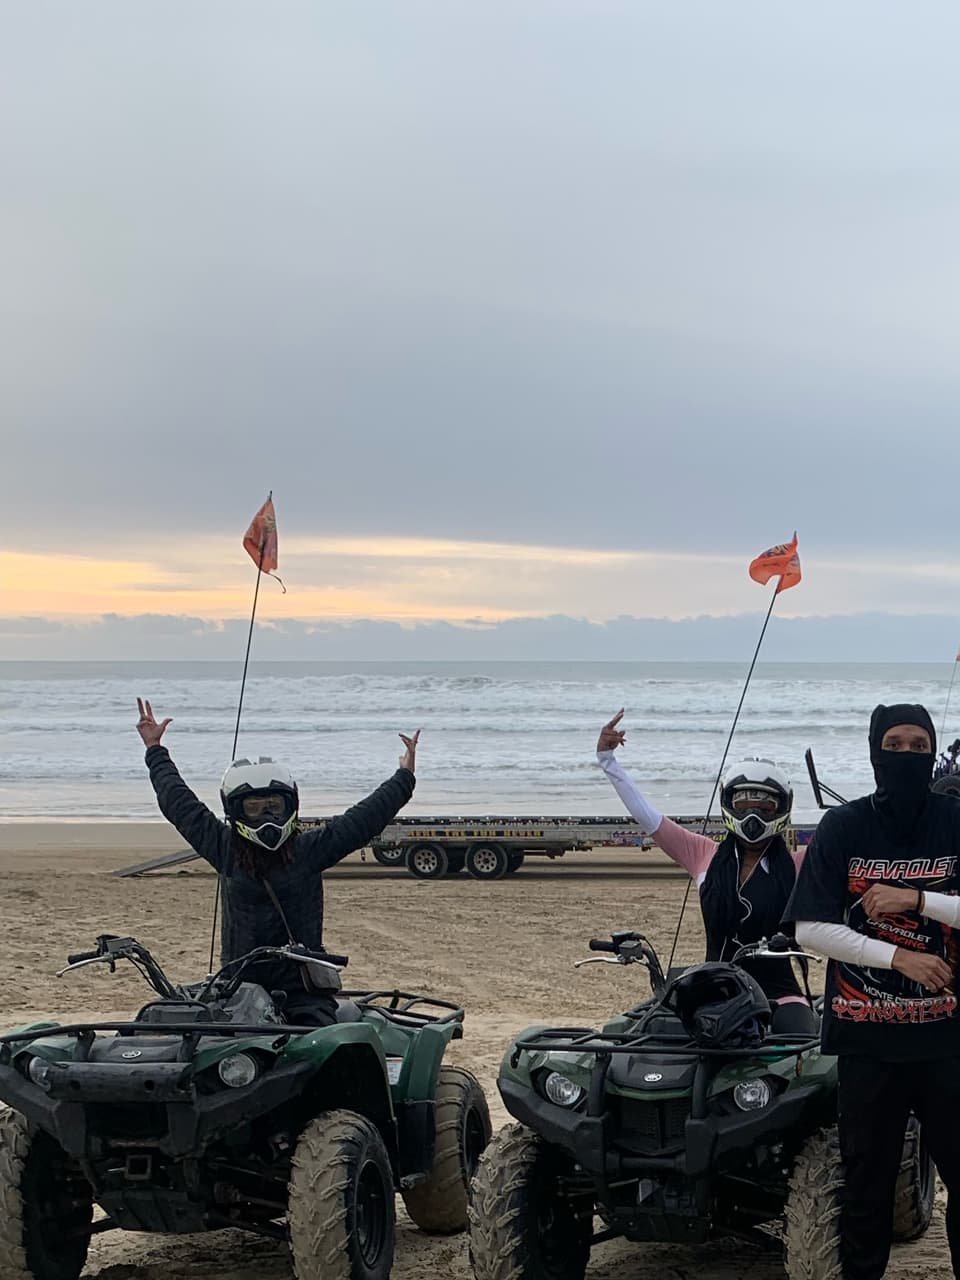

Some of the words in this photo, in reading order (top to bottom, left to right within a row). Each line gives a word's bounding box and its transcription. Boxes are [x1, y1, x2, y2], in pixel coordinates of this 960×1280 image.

[847, 856, 958, 880] CHEVROLET
[866, 918, 933, 944] CHEVROLET
[863, 984, 894, 1002] MONTE
